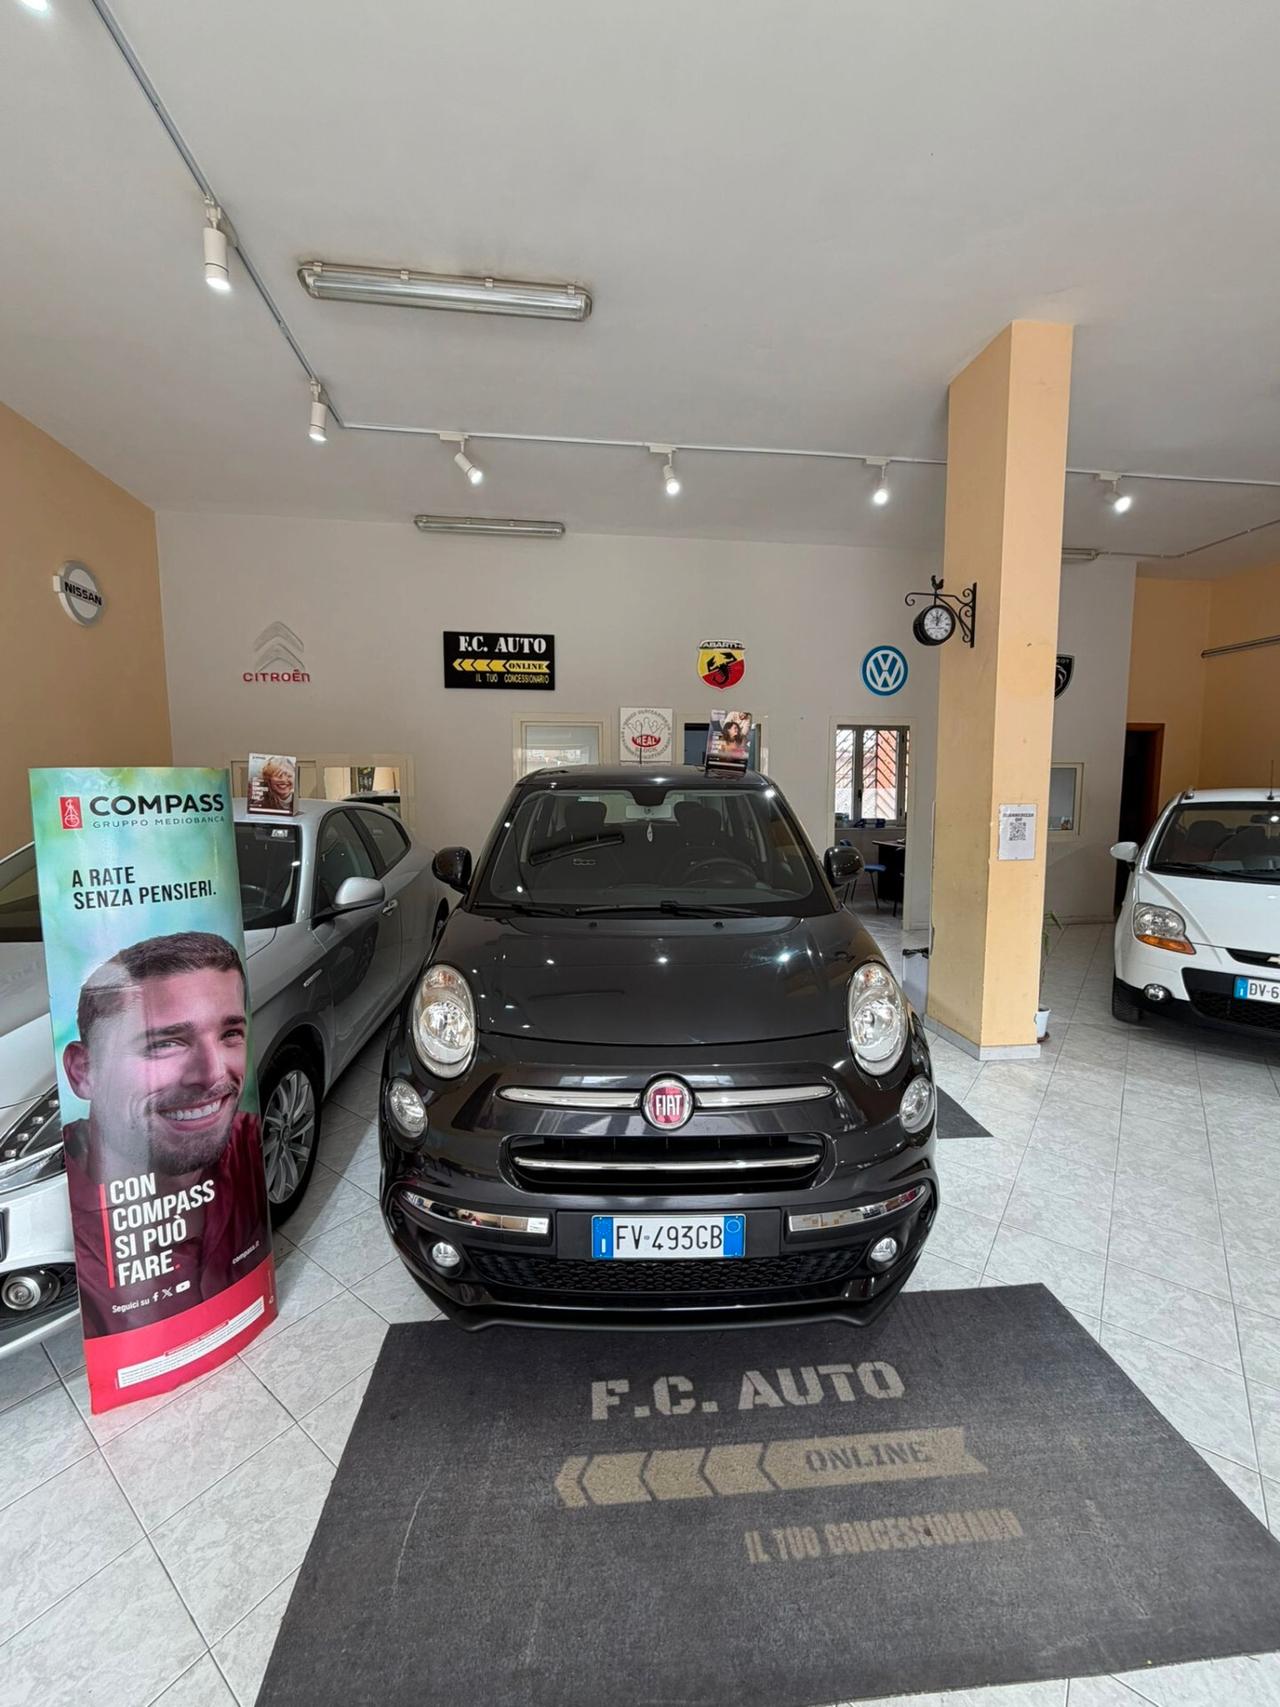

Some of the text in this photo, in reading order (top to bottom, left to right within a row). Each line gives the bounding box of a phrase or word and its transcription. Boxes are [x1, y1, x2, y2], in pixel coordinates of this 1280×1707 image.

[64, 581, 102, 606] NISSAN
[459, 635, 547, 654] F.C. AUTO
[475, 673, 549, 684] IL TUO CONCESSIONARIO
[508, 662, 545, 671] ONLINE
[89, 793, 225, 816] COMPASS
[93, 815, 225, 829] GRUPPO MEDIOBANCA
[72, 866, 136, 888] A RATE
[73, 879, 217, 910] SENZA PENSIERI.
[655, 1094, 682, 1116] FIAT
[109, 1172, 157, 1204] CON
[112, 1179, 216, 1232] COMPASS
[114, 1214, 187, 1259] SI PUÒ
[118, 1249, 181, 1287] FARE.
[111, 1297, 150, 1314] Seguici su
[591, 1361, 905, 1421] F.C. AUTO
[804, 1439, 933, 1474] ONLINE
[744, 1530, 771, 1564] IL
[772, 1525, 821, 1561] TUO
